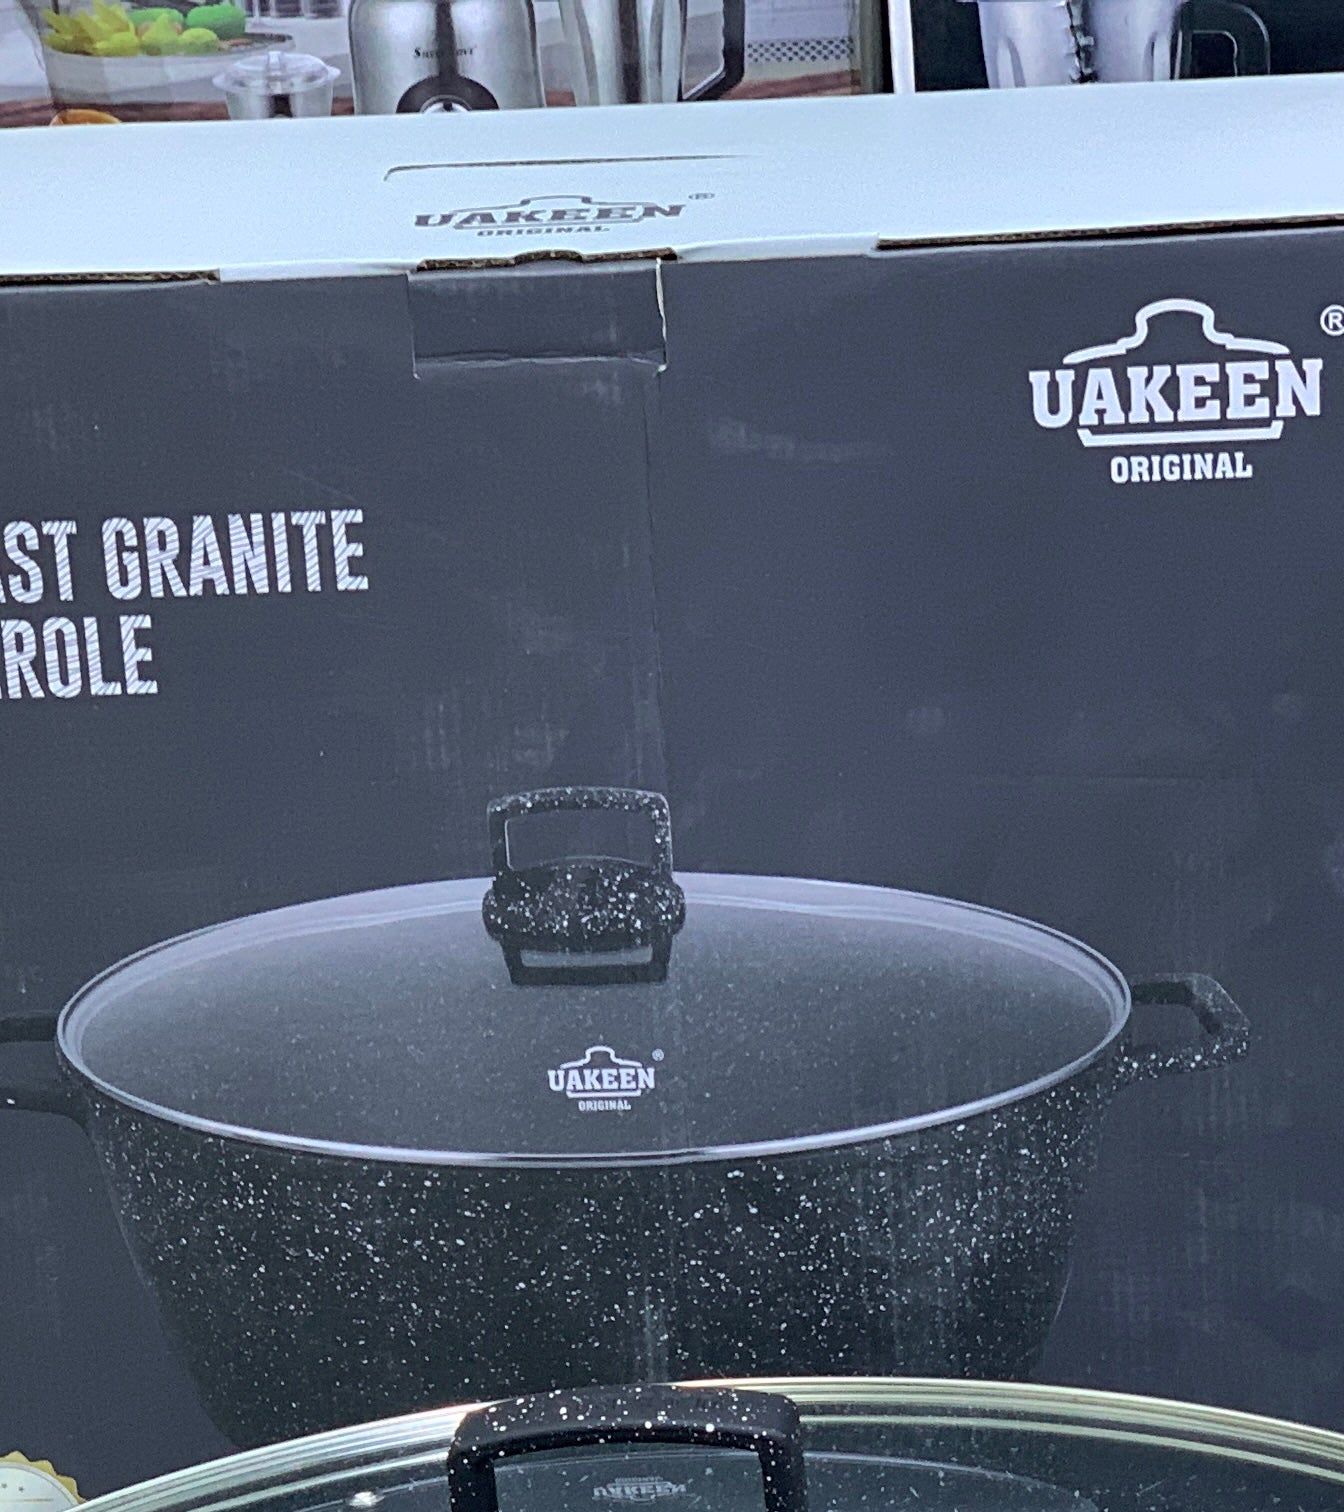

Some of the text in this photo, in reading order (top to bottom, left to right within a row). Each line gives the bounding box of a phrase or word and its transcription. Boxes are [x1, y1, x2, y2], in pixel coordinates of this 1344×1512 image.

[414, 203, 687, 228] UAKEEN
[477, 225, 610, 237] ORIGINAL
[1029, 359, 1323, 428] UAKEEN
[1111, 451, 1253, 483] ORIGINAL
[100, 509, 370, 601] GRANITE
[547, 1067, 655, 1091] UAKEEN
[578, 1099, 631, 1112] ORIGINAL
